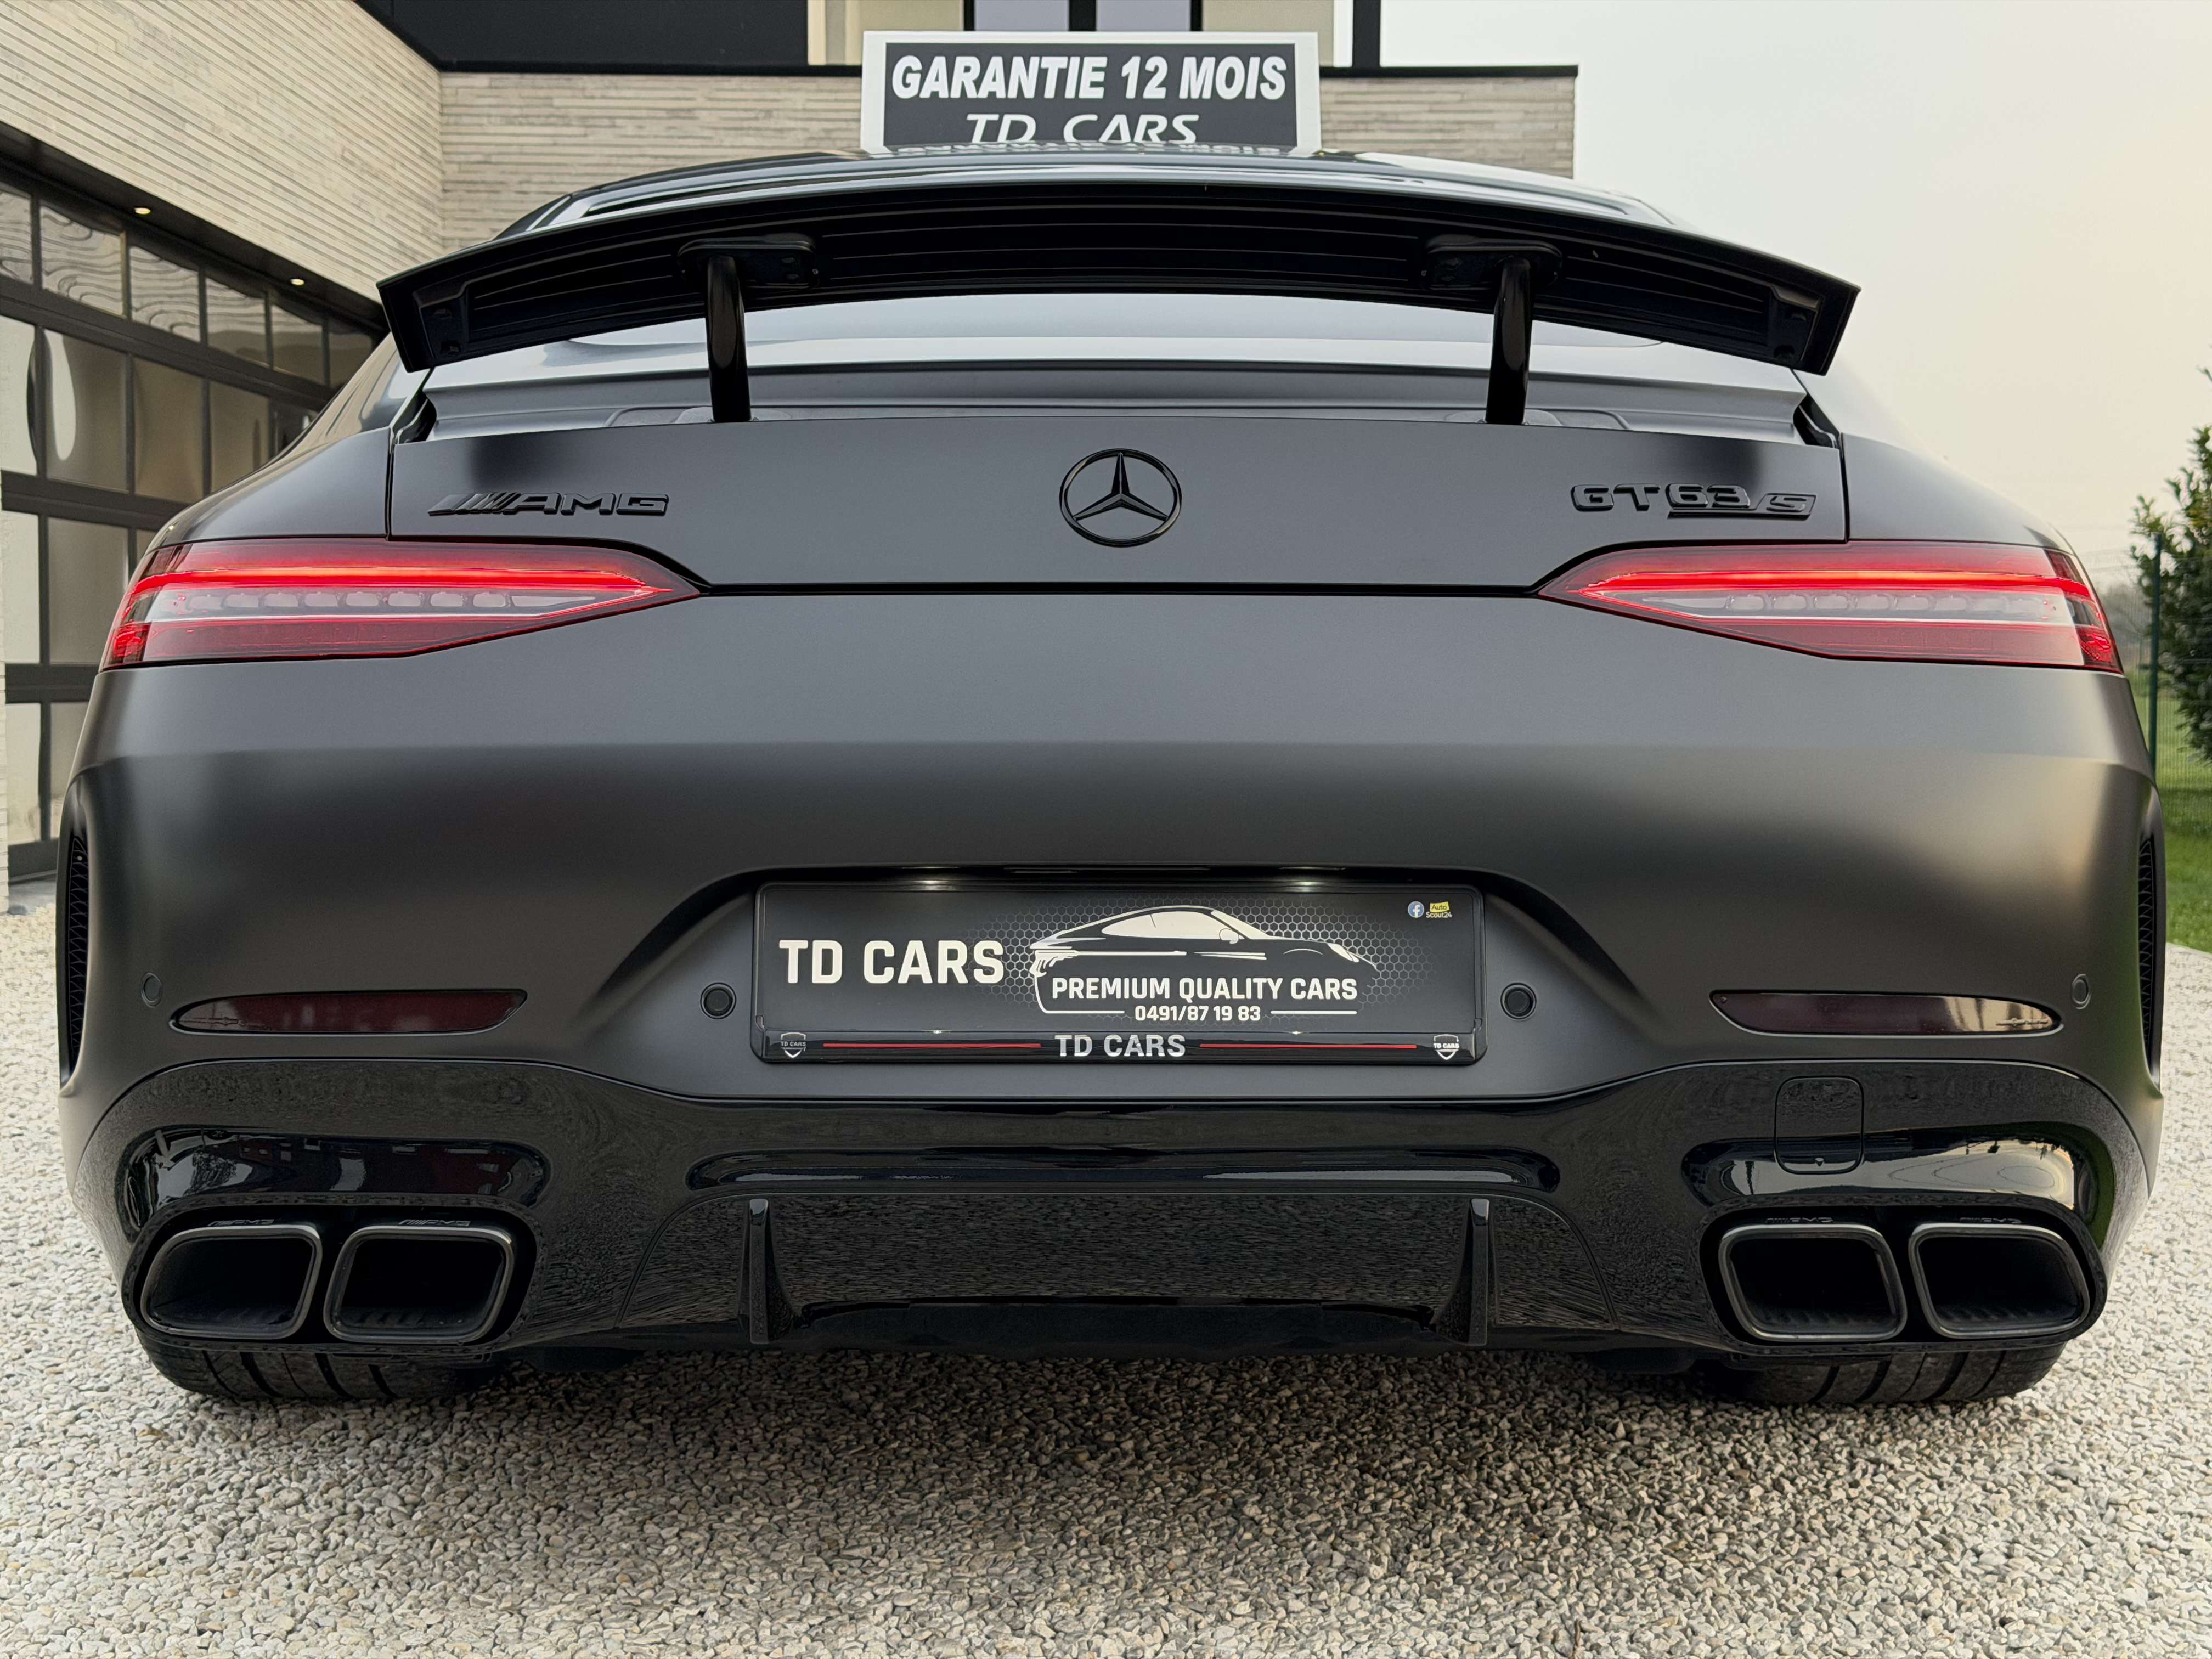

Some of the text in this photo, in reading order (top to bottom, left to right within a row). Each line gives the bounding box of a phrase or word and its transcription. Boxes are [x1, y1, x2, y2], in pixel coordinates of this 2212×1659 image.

[892, 55, 1287, 99] GARANTIE 12 MOIS
[966, 114, 1199, 143] TD CARS
[504, 492, 669, 516] AMG
[779, 940, 1004, 984] TD CARS
[1052, 978, 1358, 1003] PREMIUM QUALITY CARS
[1135, 1005, 1261, 1022] 0491/87 19 83
[1054, 1035, 1186, 1057] TD CARS
